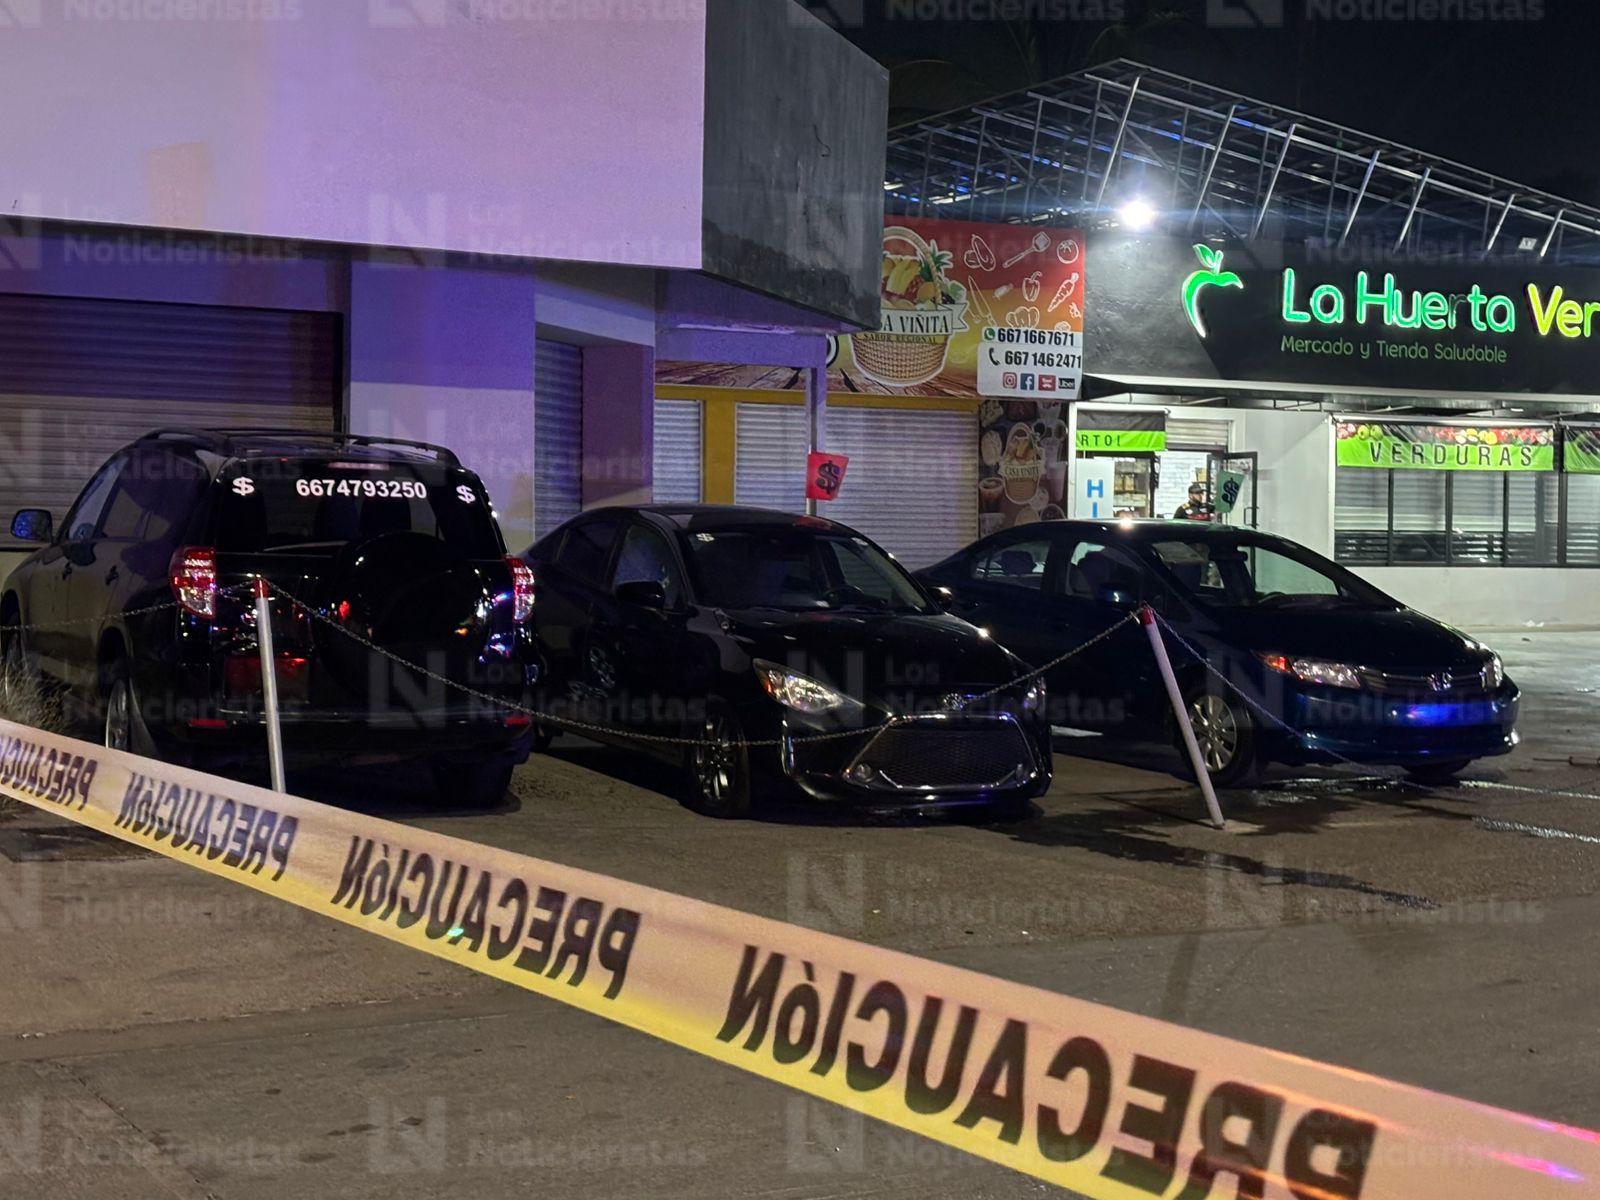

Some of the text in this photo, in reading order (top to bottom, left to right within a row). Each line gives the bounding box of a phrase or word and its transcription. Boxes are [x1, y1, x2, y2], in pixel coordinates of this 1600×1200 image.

[1282, 267, 1344, 324] La
[1356, 270, 1516, 334] Huerta
[900, 313, 949, 334] VIÑITA
[1281, 335, 1508, 364] Mercado y Tienda Saludable
[1369, 441, 1532, 467] VERDURAS
[296, 479, 427, 499] 6674793250
